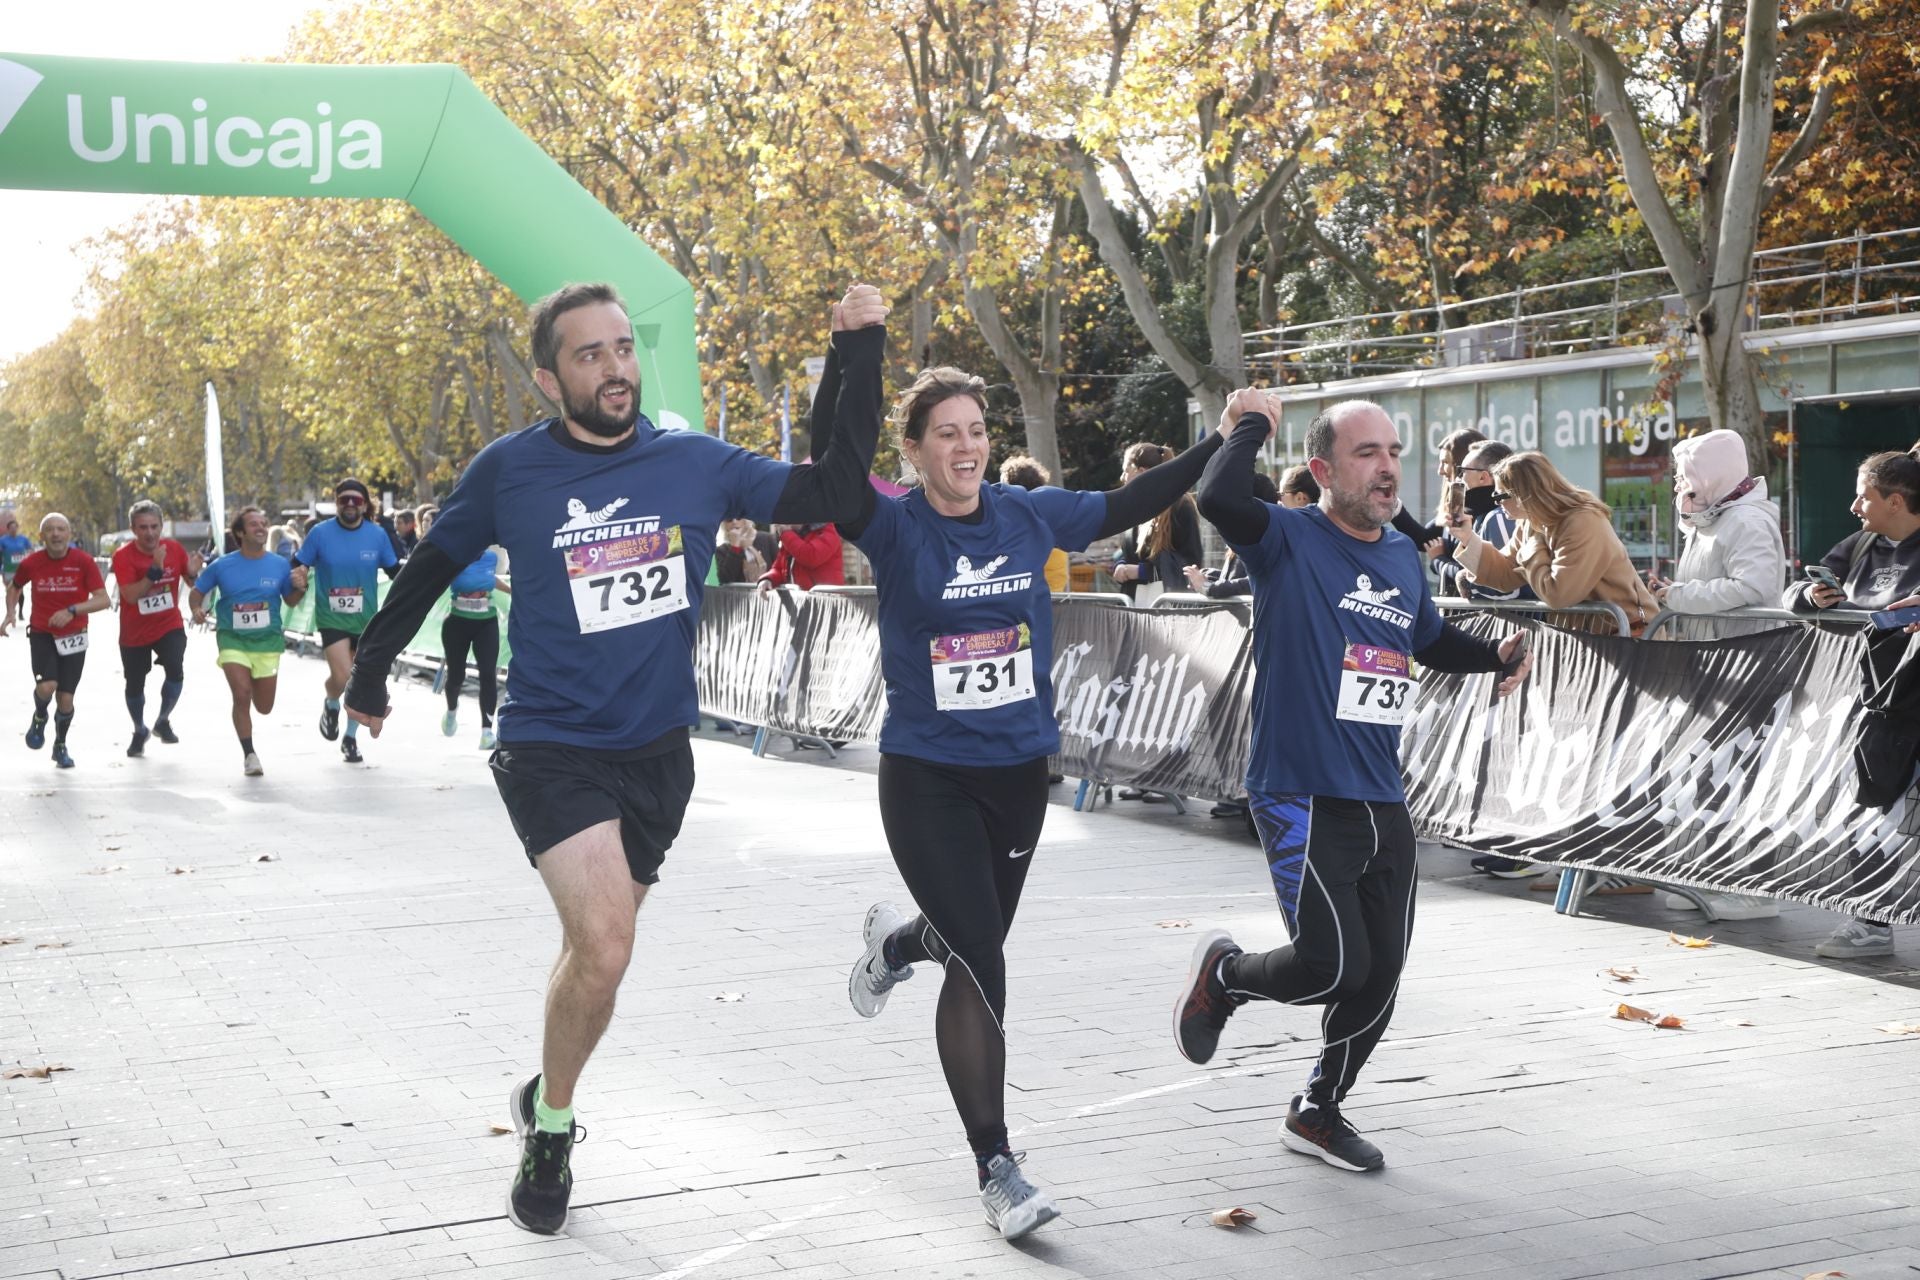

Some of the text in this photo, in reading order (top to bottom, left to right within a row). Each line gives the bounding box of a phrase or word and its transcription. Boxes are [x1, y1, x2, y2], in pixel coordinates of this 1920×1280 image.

[67, 93, 382, 184] Unicaja
[1555, 390, 1677, 456] amiga
[552, 521, 660, 549] MICHELIN
[604, 539, 637, 553] CARRERA
[638, 536, 649, 546] DE
[606, 544, 650, 562] EMPRESAS
[589, 565, 672, 612] 732
[942, 577, 1032, 600] MICHELIN
[143, 596, 168, 609] 121
[338, 597, 355, 608] 92
[241, 612, 259, 624] 91
[1338, 597, 1412, 630] MICHELIN
[60, 635, 85, 649] 122
[966, 632, 996, 644] CARRERA
[996, 631, 1006, 640] DE
[966, 639, 1006, 651] EMPRESAS
[1376, 656, 1403, 669] EMPRESAS
[949, 657, 1016, 694] 731
[1050, 640, 1208, 755] Castilla
[1356, 675, 1410, 710] 733
